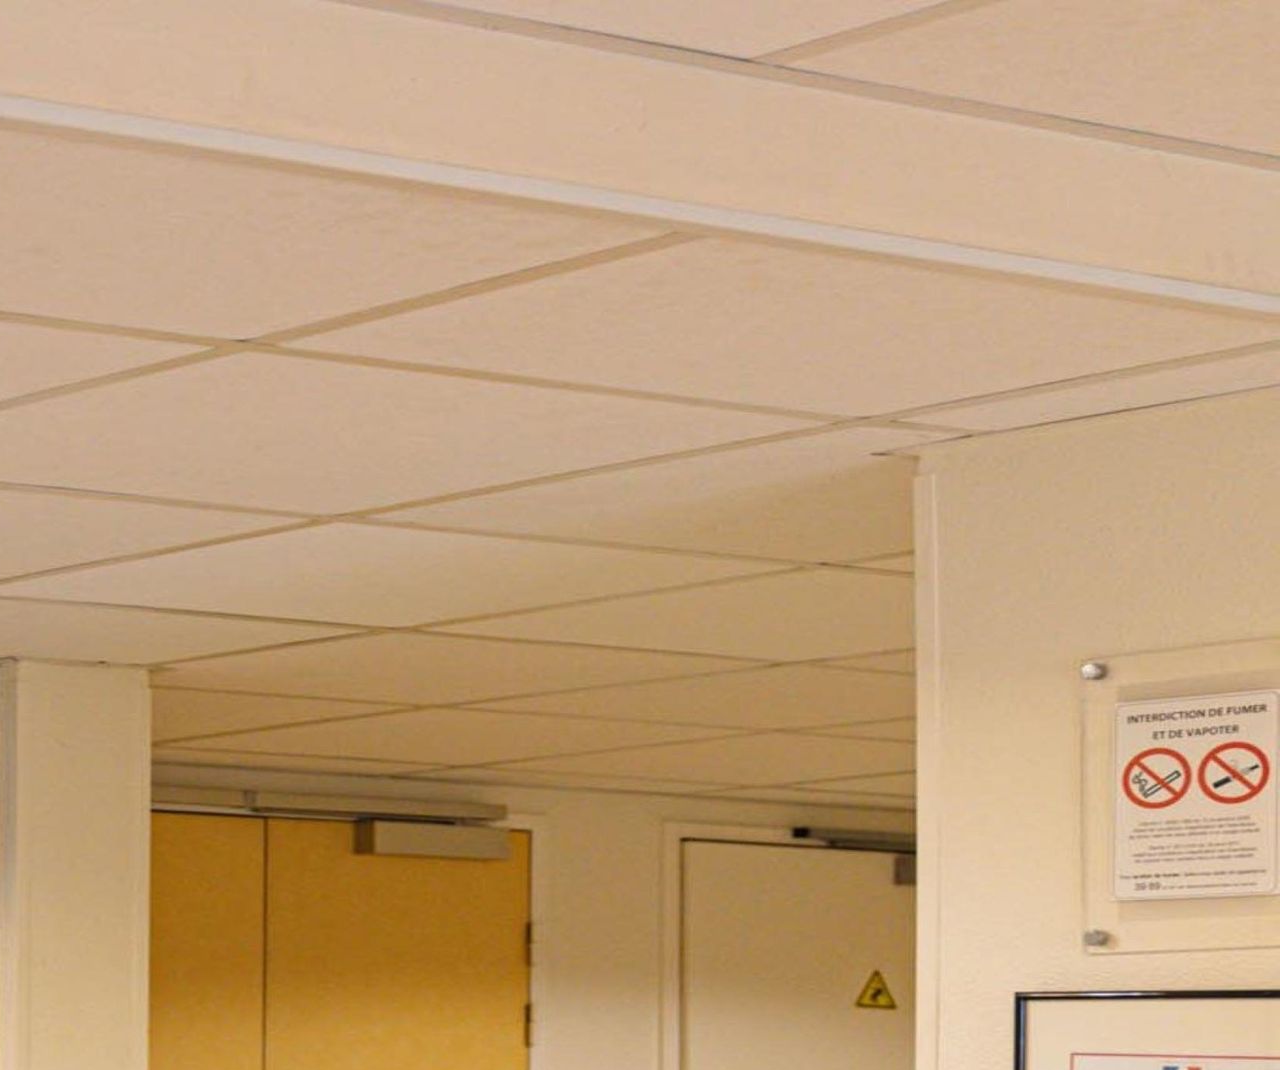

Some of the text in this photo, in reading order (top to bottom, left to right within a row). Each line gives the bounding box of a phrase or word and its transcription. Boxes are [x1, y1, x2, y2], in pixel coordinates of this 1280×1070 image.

[1127, 704, 1268, 724] INTERDICTION DE FUMER
[1152, 725, 1240, 740] ET DE VAPOTER
